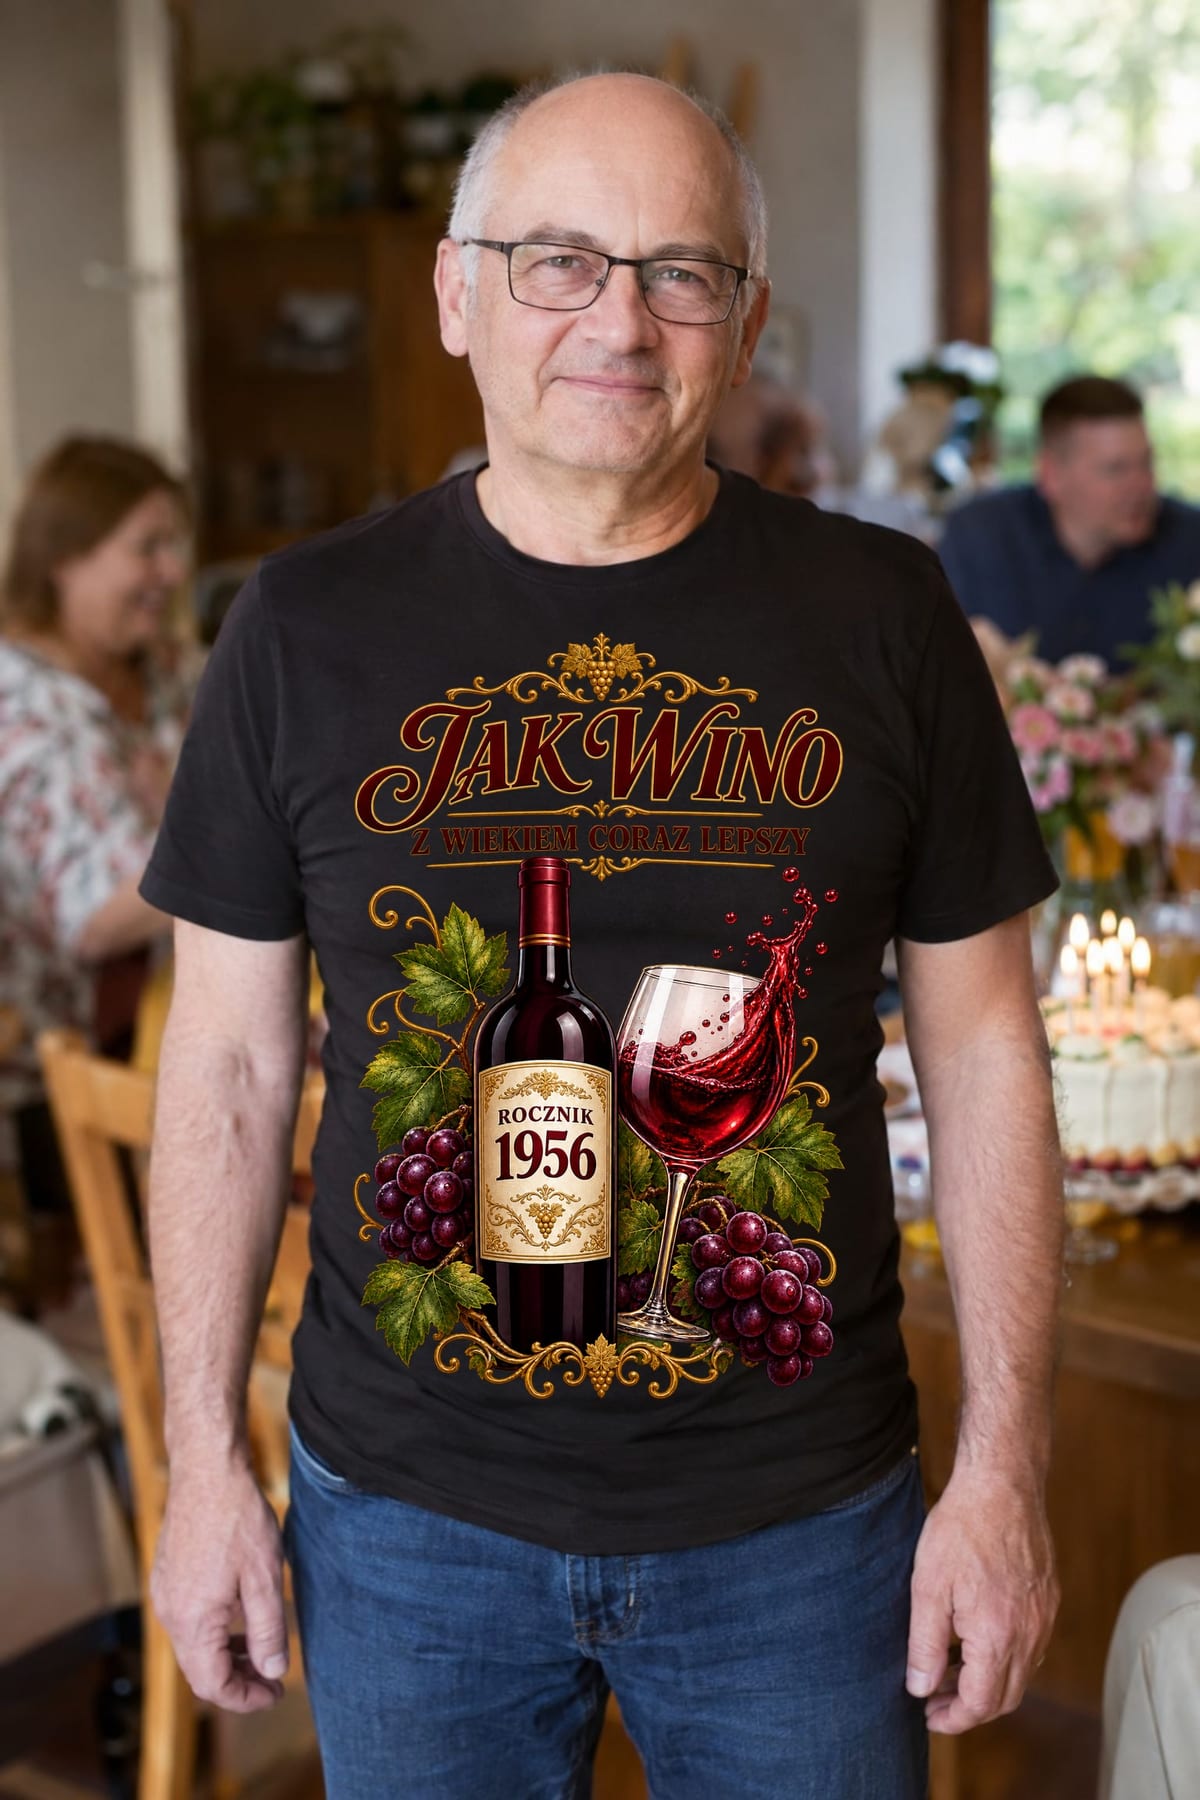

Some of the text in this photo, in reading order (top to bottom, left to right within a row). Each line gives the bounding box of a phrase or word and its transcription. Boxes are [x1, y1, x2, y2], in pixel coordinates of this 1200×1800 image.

[355, 700, 843, 833] JAK WINO
[410, 824, 811, 856] Z WIEKIEM CORAZ LEPSZY
[498, 1106, 594, 1125] ROCZNIK
[495, 1130, 597, 1181] 1956
